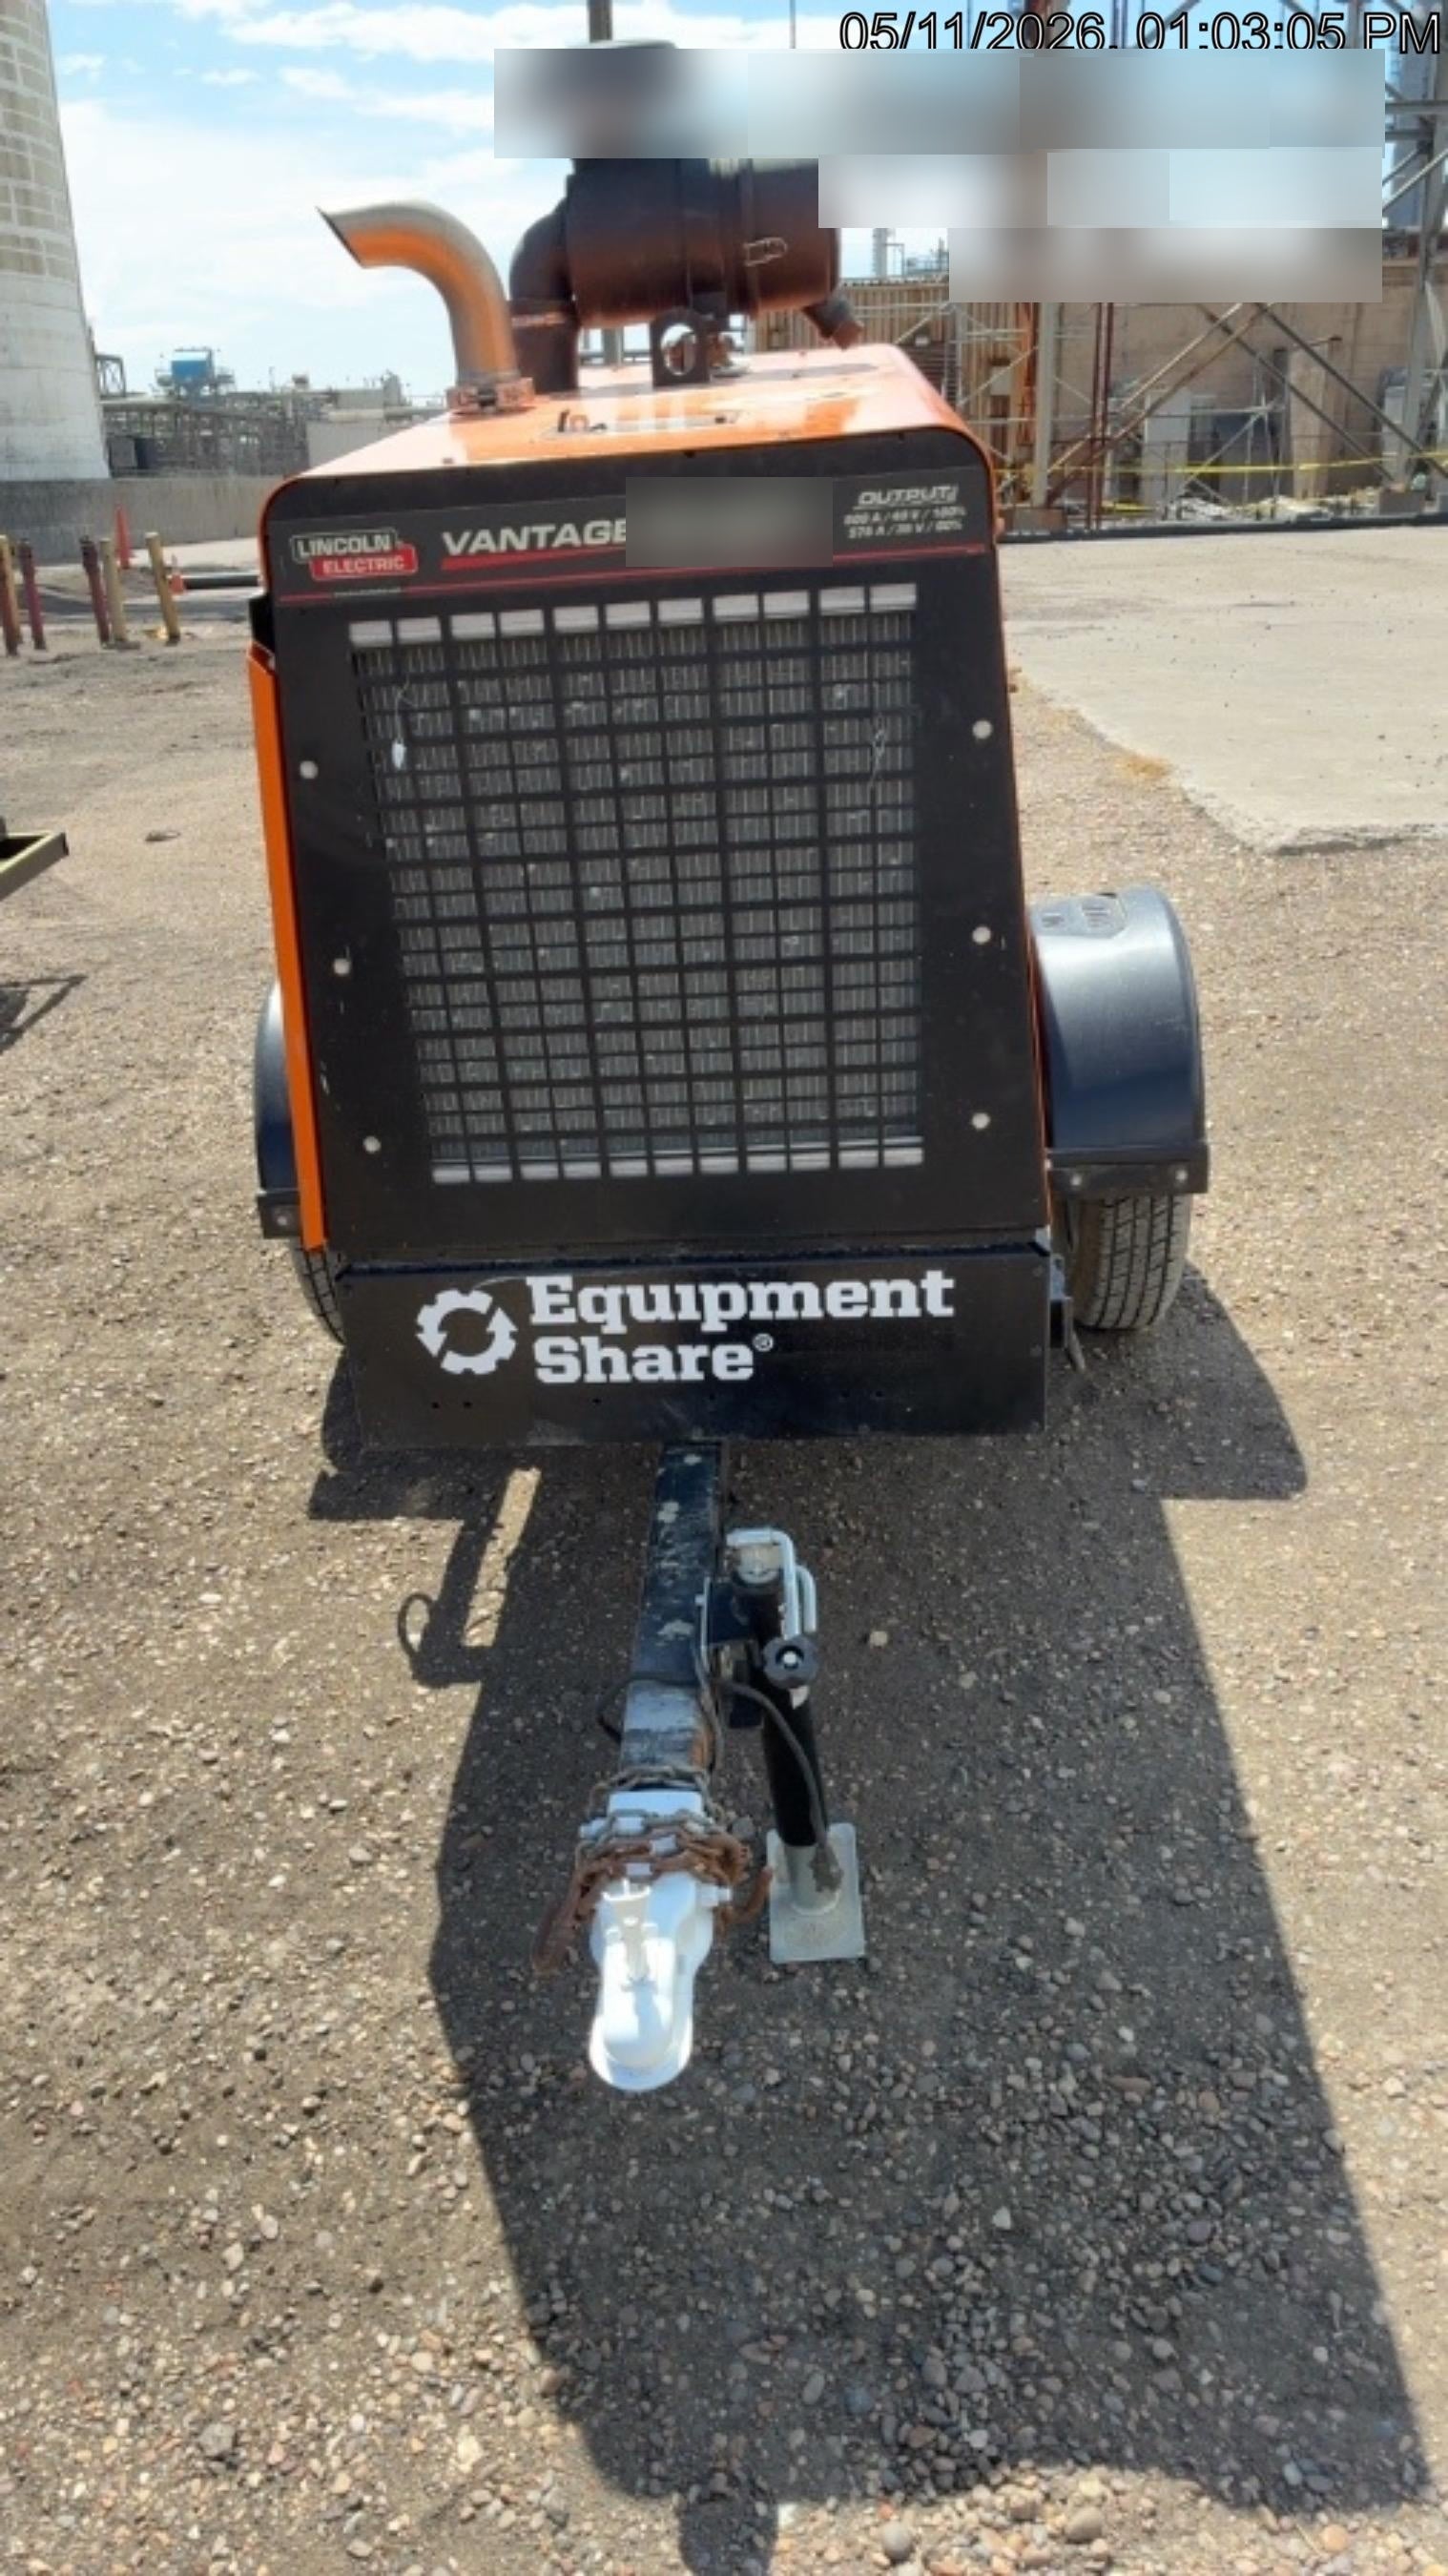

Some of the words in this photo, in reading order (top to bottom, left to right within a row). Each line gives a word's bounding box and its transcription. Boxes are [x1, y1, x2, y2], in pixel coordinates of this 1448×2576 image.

[298, 533, 391, 556] LINCOLN
[322, 556, 405, 573] ELECTRIC
[526, 1270, 955, 1334] Equipment
